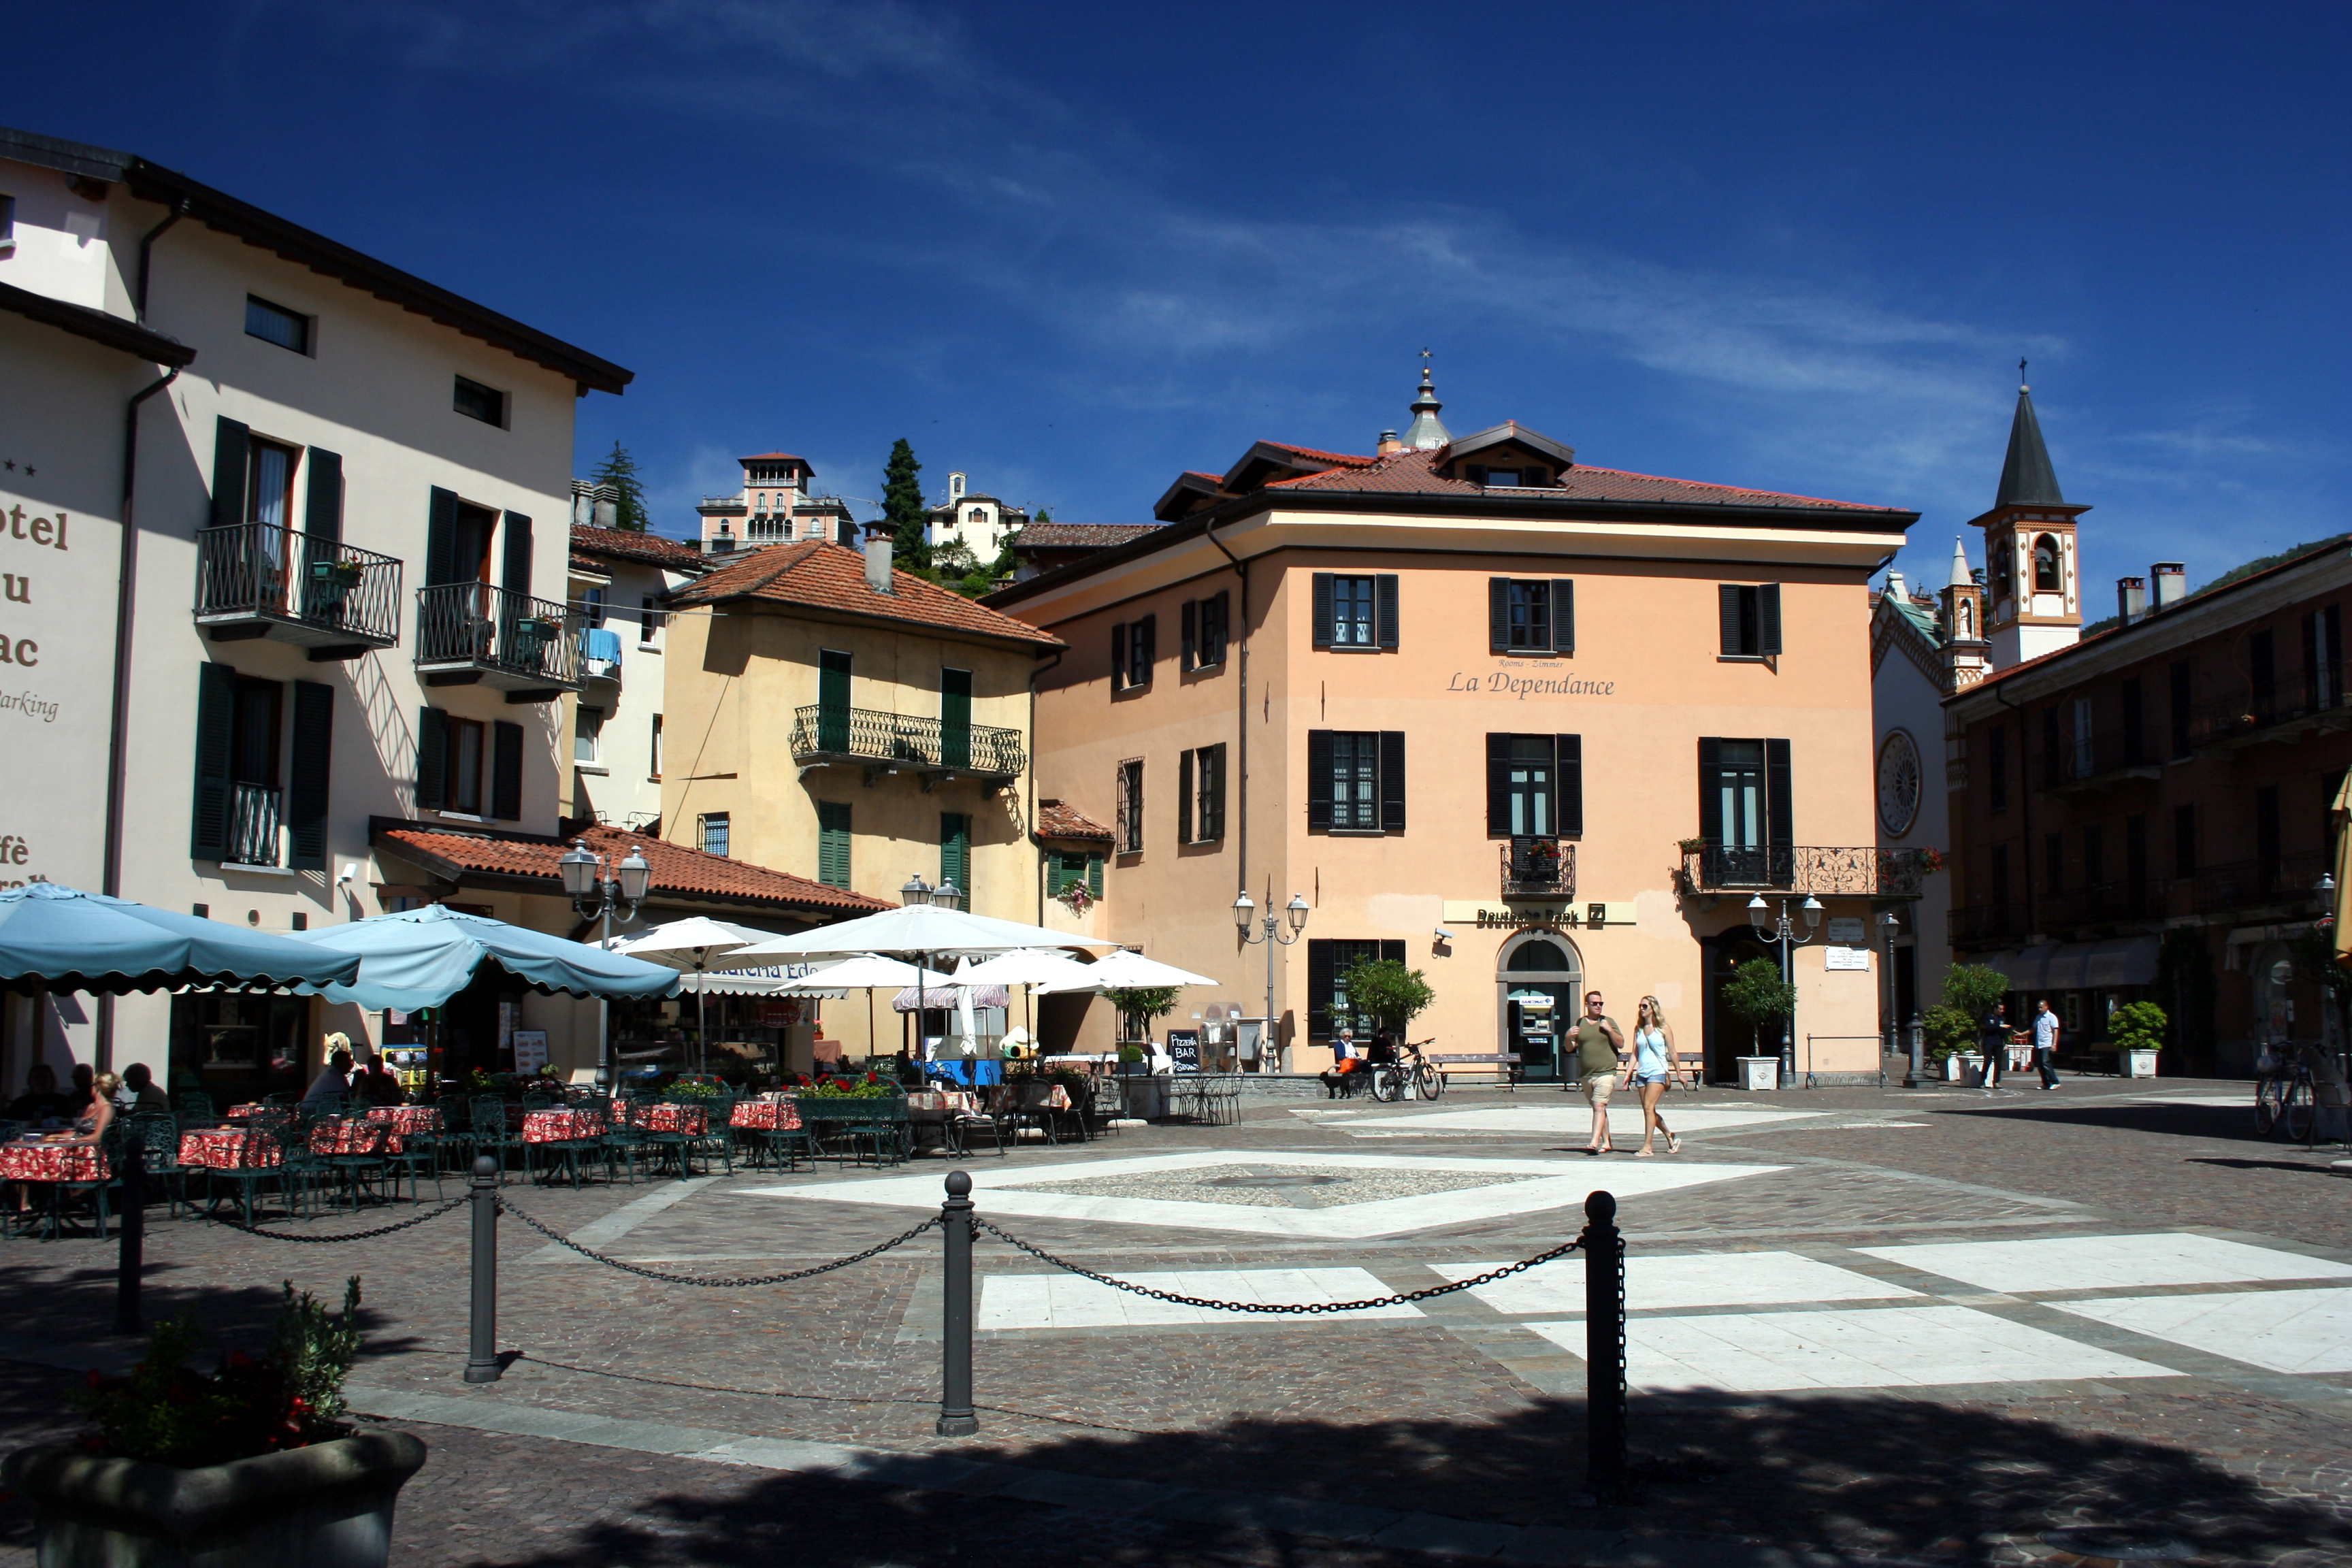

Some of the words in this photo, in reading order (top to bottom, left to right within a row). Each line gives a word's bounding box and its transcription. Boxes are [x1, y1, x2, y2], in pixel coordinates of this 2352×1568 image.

[0, 504, 68, 551] tel
[1499, 659, 1524, 668] Rooms
[1531, 659, 1564, 668] Zimmer
[1446, 672, 1480, 691] La
[1488, 672, 1615, 700] Dependance
[0, 690, 59, 723] arking
[0, 835, 29, 865] fè
[1477, 909, 1541, 921] Deutsche
[1545, 910, 1580, 921] Bank
[1175, 1047, 1196, 1058] BAR
